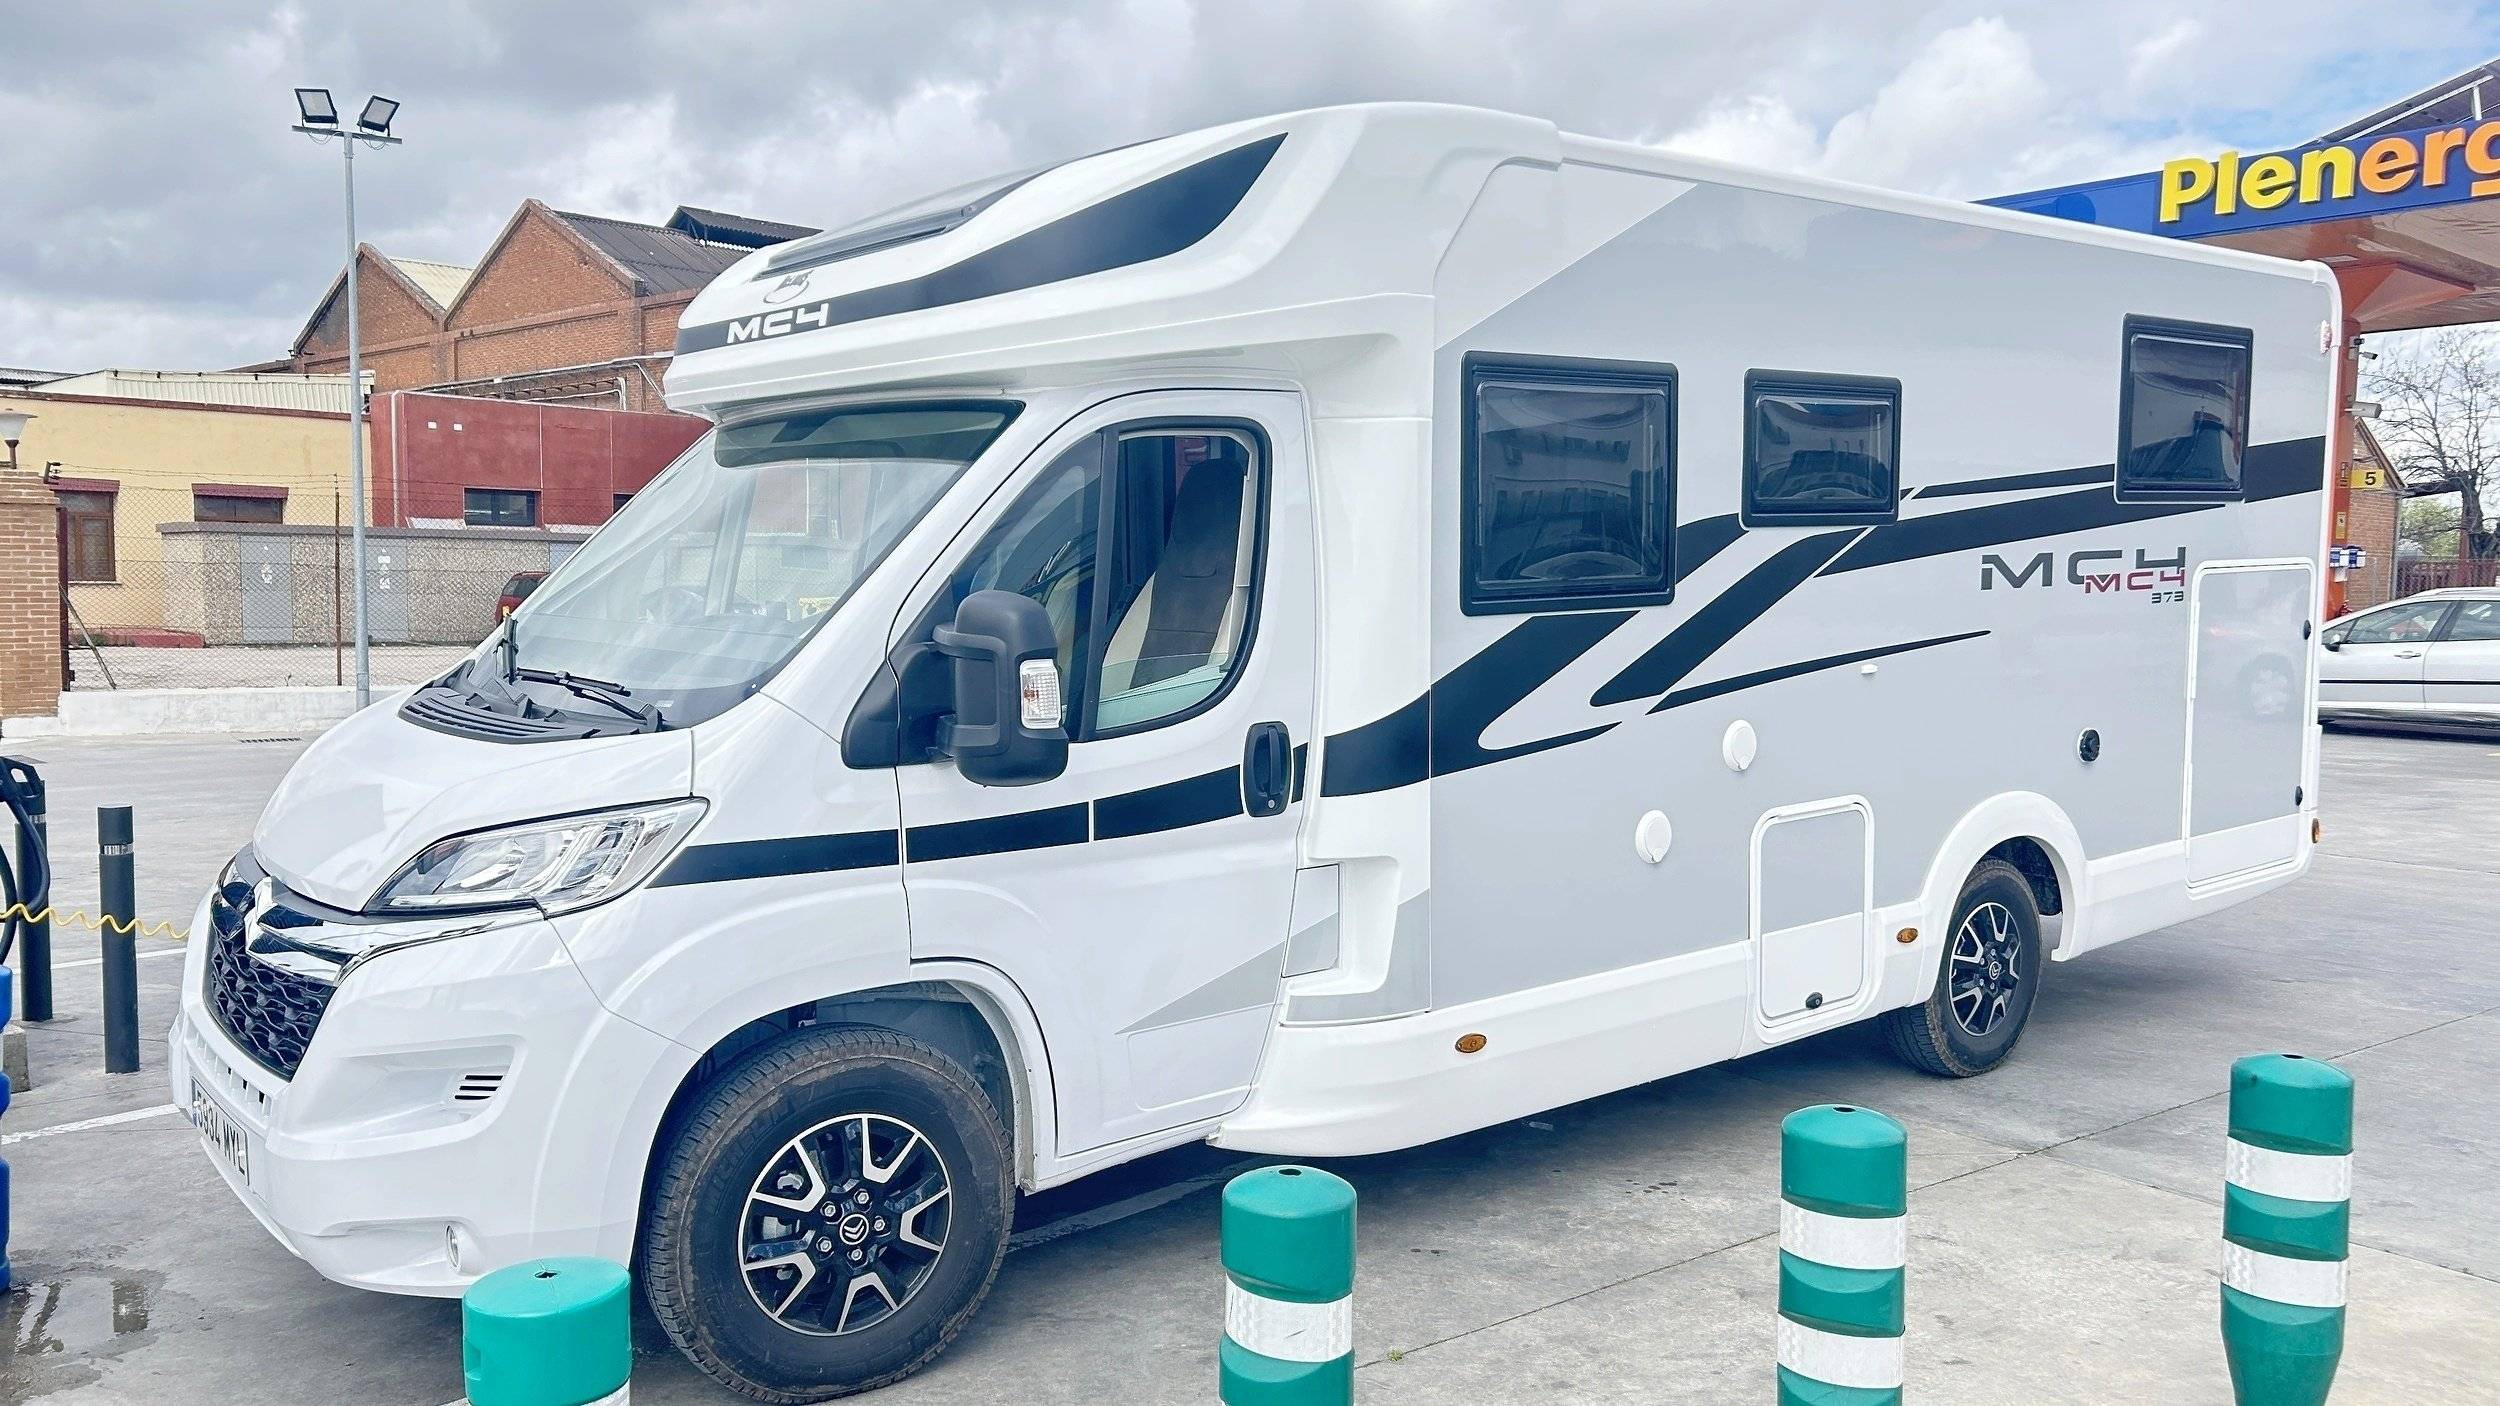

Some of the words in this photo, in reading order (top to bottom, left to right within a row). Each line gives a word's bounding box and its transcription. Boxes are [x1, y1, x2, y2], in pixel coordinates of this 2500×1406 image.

[727, 303, 829, 344] MC4
[2365, 472, 2376, 486] 5
[1981, 546, 2186, 590] MC4
[2085, 569, 2185, 594] MC4
[2151, 591, 2184, 604] 373
